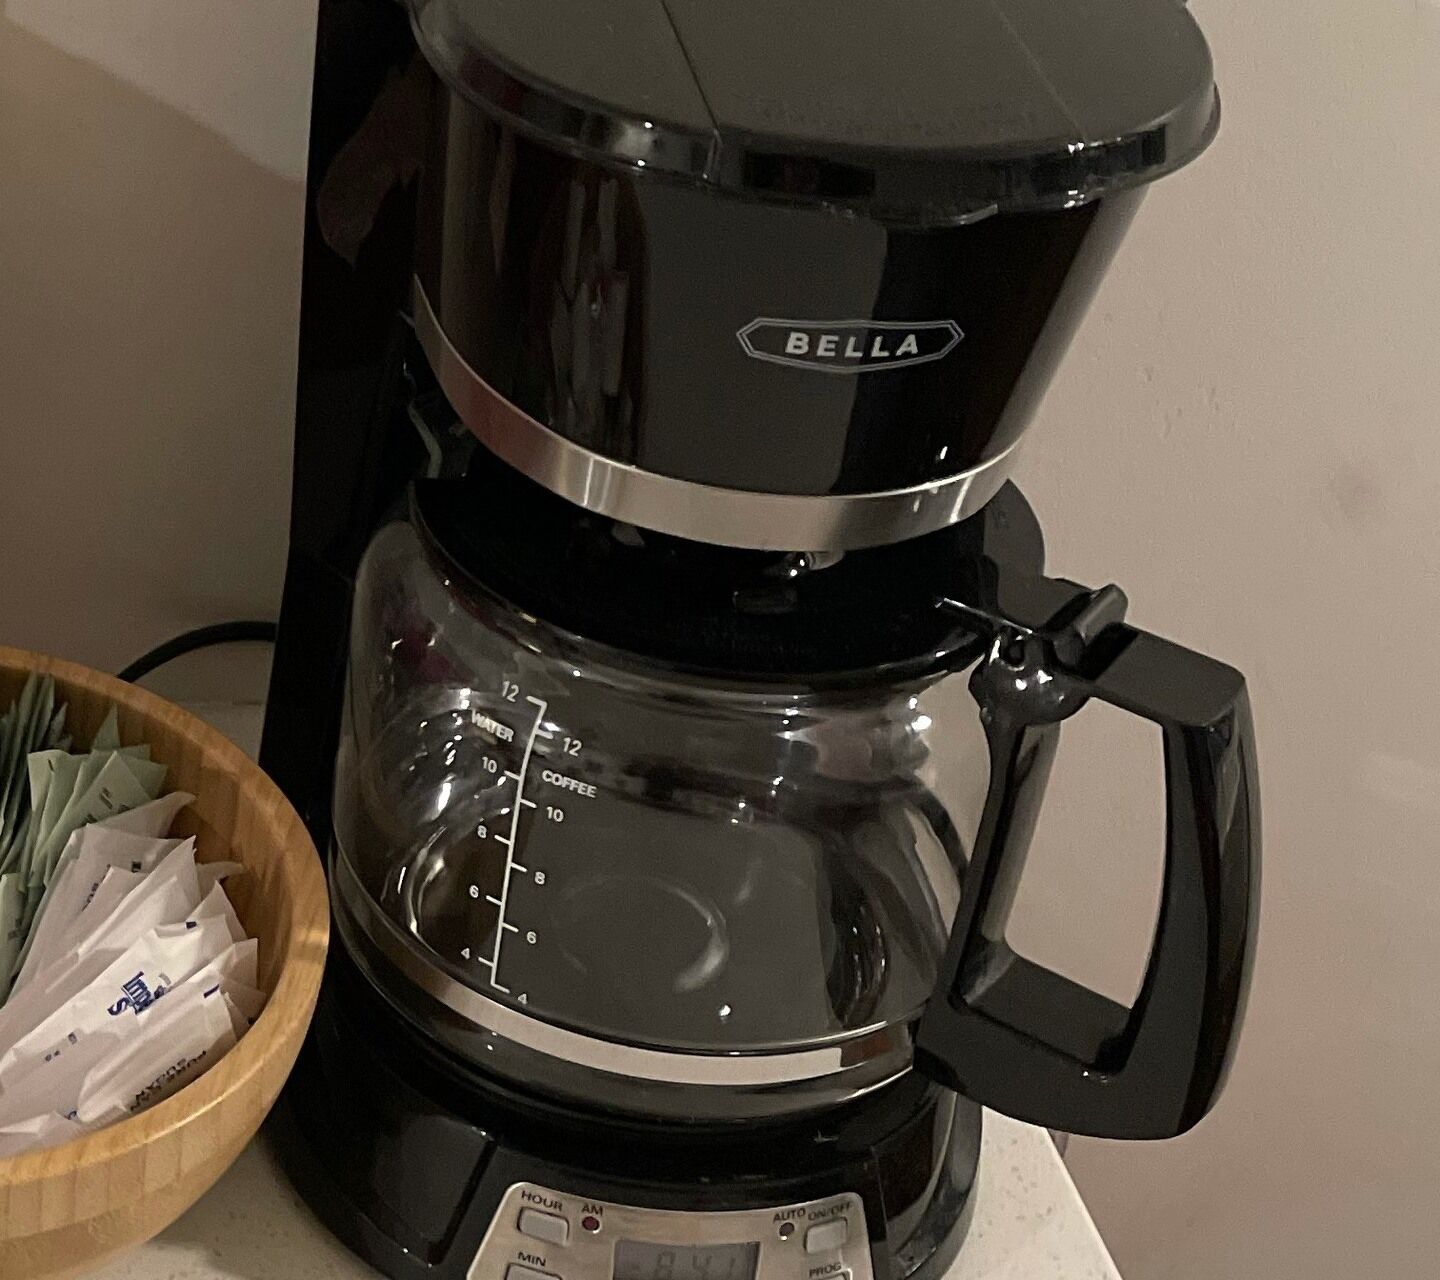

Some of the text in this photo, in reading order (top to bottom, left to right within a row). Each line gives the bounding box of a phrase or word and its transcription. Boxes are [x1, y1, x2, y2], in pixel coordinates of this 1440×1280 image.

[785, 331, 919, 357] BELLA
[501, 681, 520, 702] 12
[471, 709, 515, 742] WATER
[563, 736, 583, 757] 12
[481, 756, 497, 772] 10
[541, 770, 597, 798] COFFEE
[546, 806, 564, 822] 10
[476, 825, 488, 839] 8
[534, 872, 545, 885] 8
[469, 885, 480, 898] 6
[526, 931, 537, 944] 6
[460, 947, 471, 960] 4
[521, 1190, 563, 1212] HOUR
[581, 1203, 603, 1217] AM
[773, 1208, 806, 1224] AUTO
[807, 1201, 850, 1221] ON/OFF
[517, 1251, 546, 1267] MIN
[808, 1261, 842, 1277] PROG
